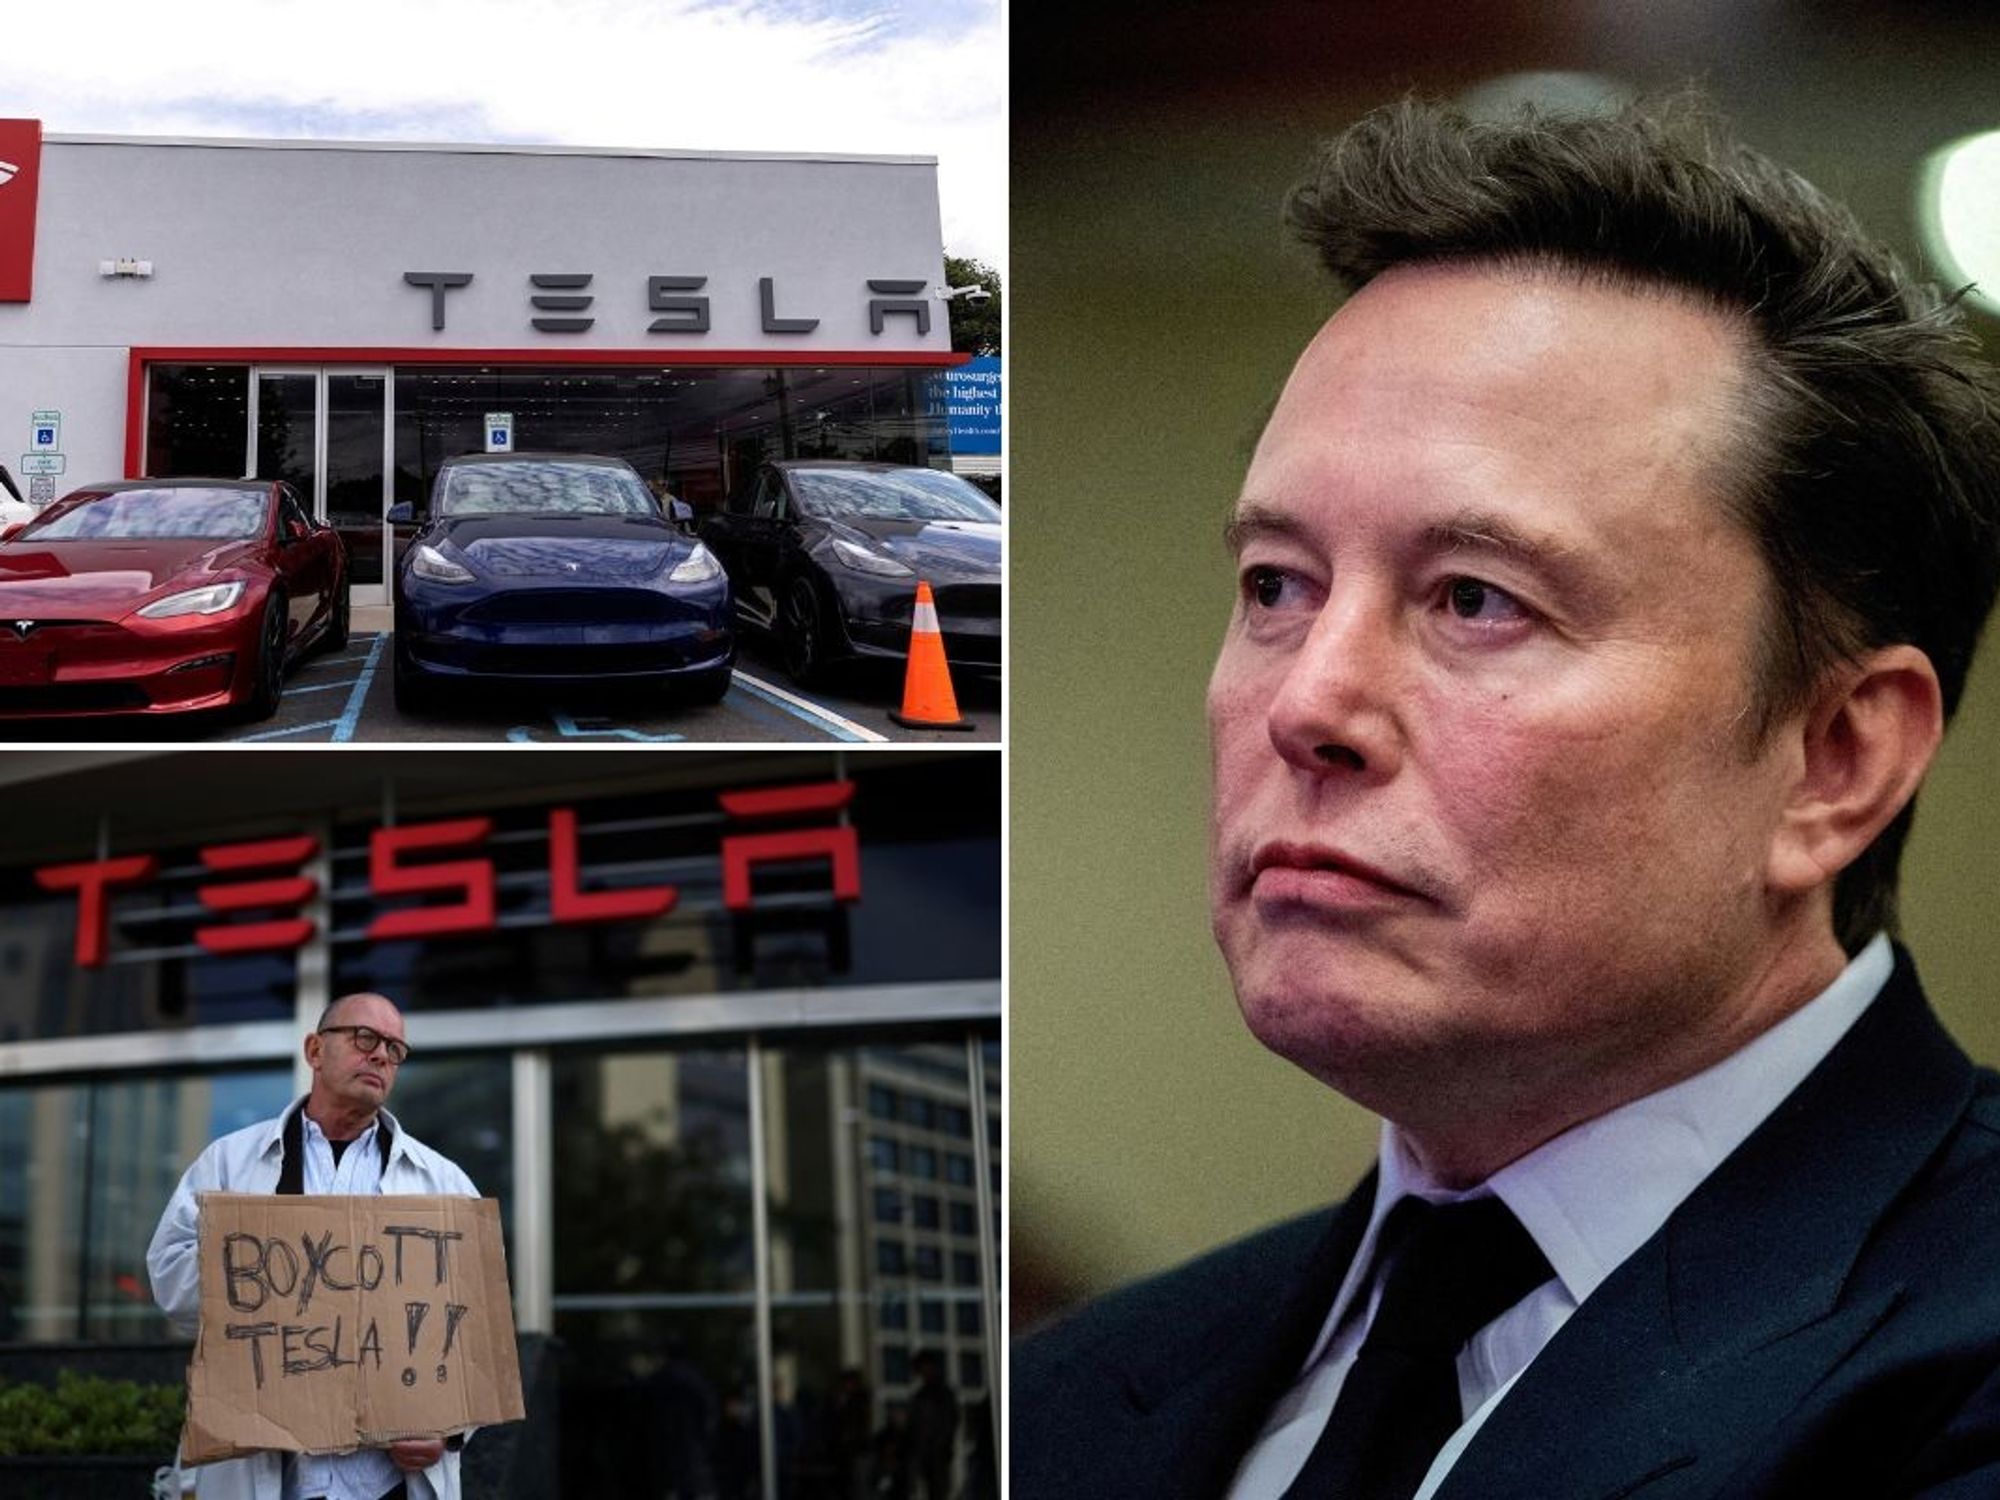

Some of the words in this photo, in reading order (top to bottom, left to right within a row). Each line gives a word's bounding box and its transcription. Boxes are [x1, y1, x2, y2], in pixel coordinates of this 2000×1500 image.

[403, 272, 931, 335] TESLA
[953, 386, 997, 401] highest
[34, 781, 861, 968] TESLA
[223, 1225, 463, 1316] BOYCOTT
